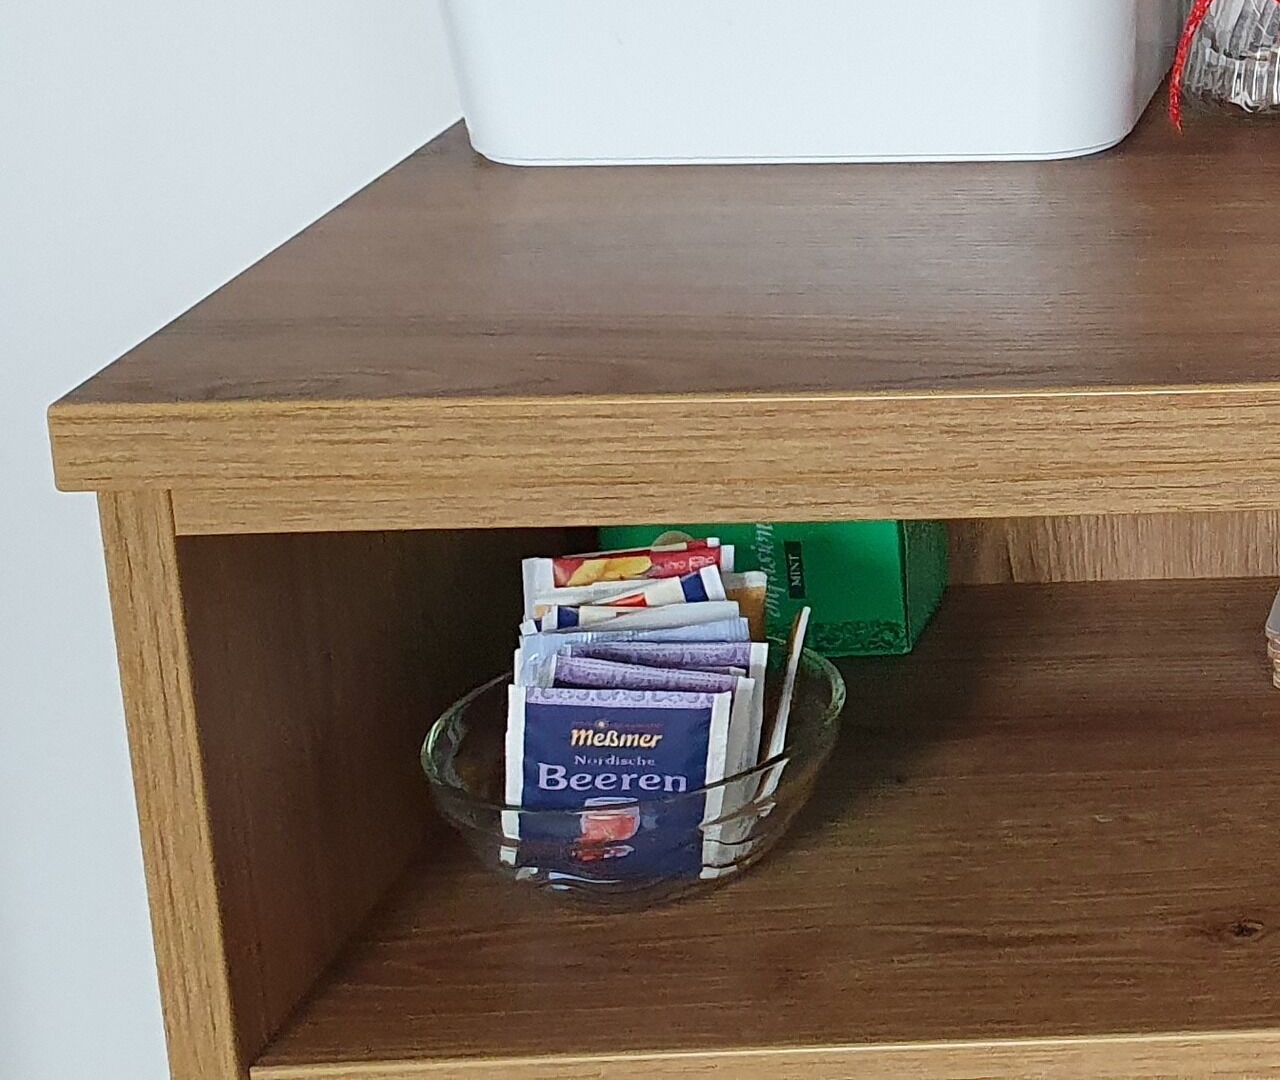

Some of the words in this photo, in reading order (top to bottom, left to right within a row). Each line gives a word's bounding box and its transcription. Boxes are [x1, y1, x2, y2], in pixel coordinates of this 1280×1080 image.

[788, 553, 801, 587] MINT
[570, 728, 663, 749] Meßmer
[574, 755, 656, 767] Nordische
[537, 762, 687, 793] Beeren
